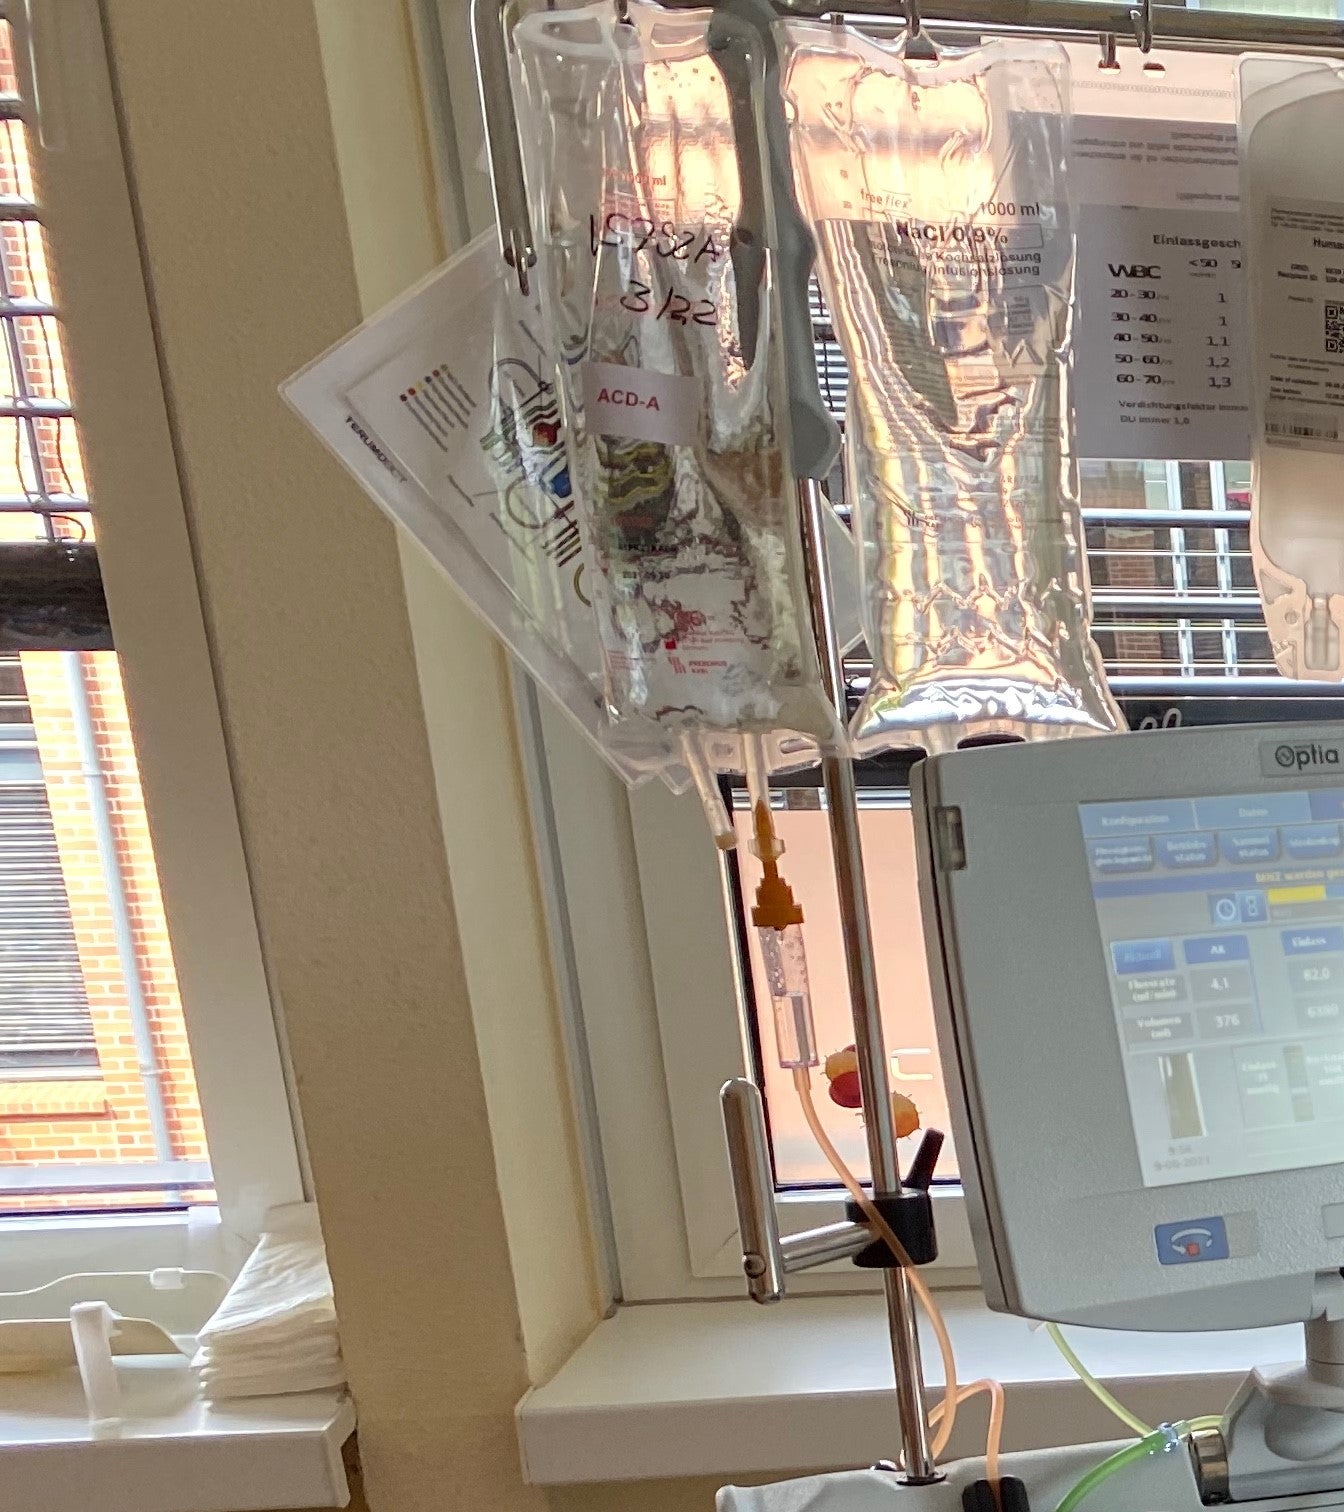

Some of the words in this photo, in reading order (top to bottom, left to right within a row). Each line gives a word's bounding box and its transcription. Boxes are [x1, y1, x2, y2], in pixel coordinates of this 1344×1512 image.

[1020, 202, 1040, 216] ml
[897, 222, 946, 242] NaCl
[1108, 264, 1161, 279] WBC
[597, 388, 661, 412] ACD-A
